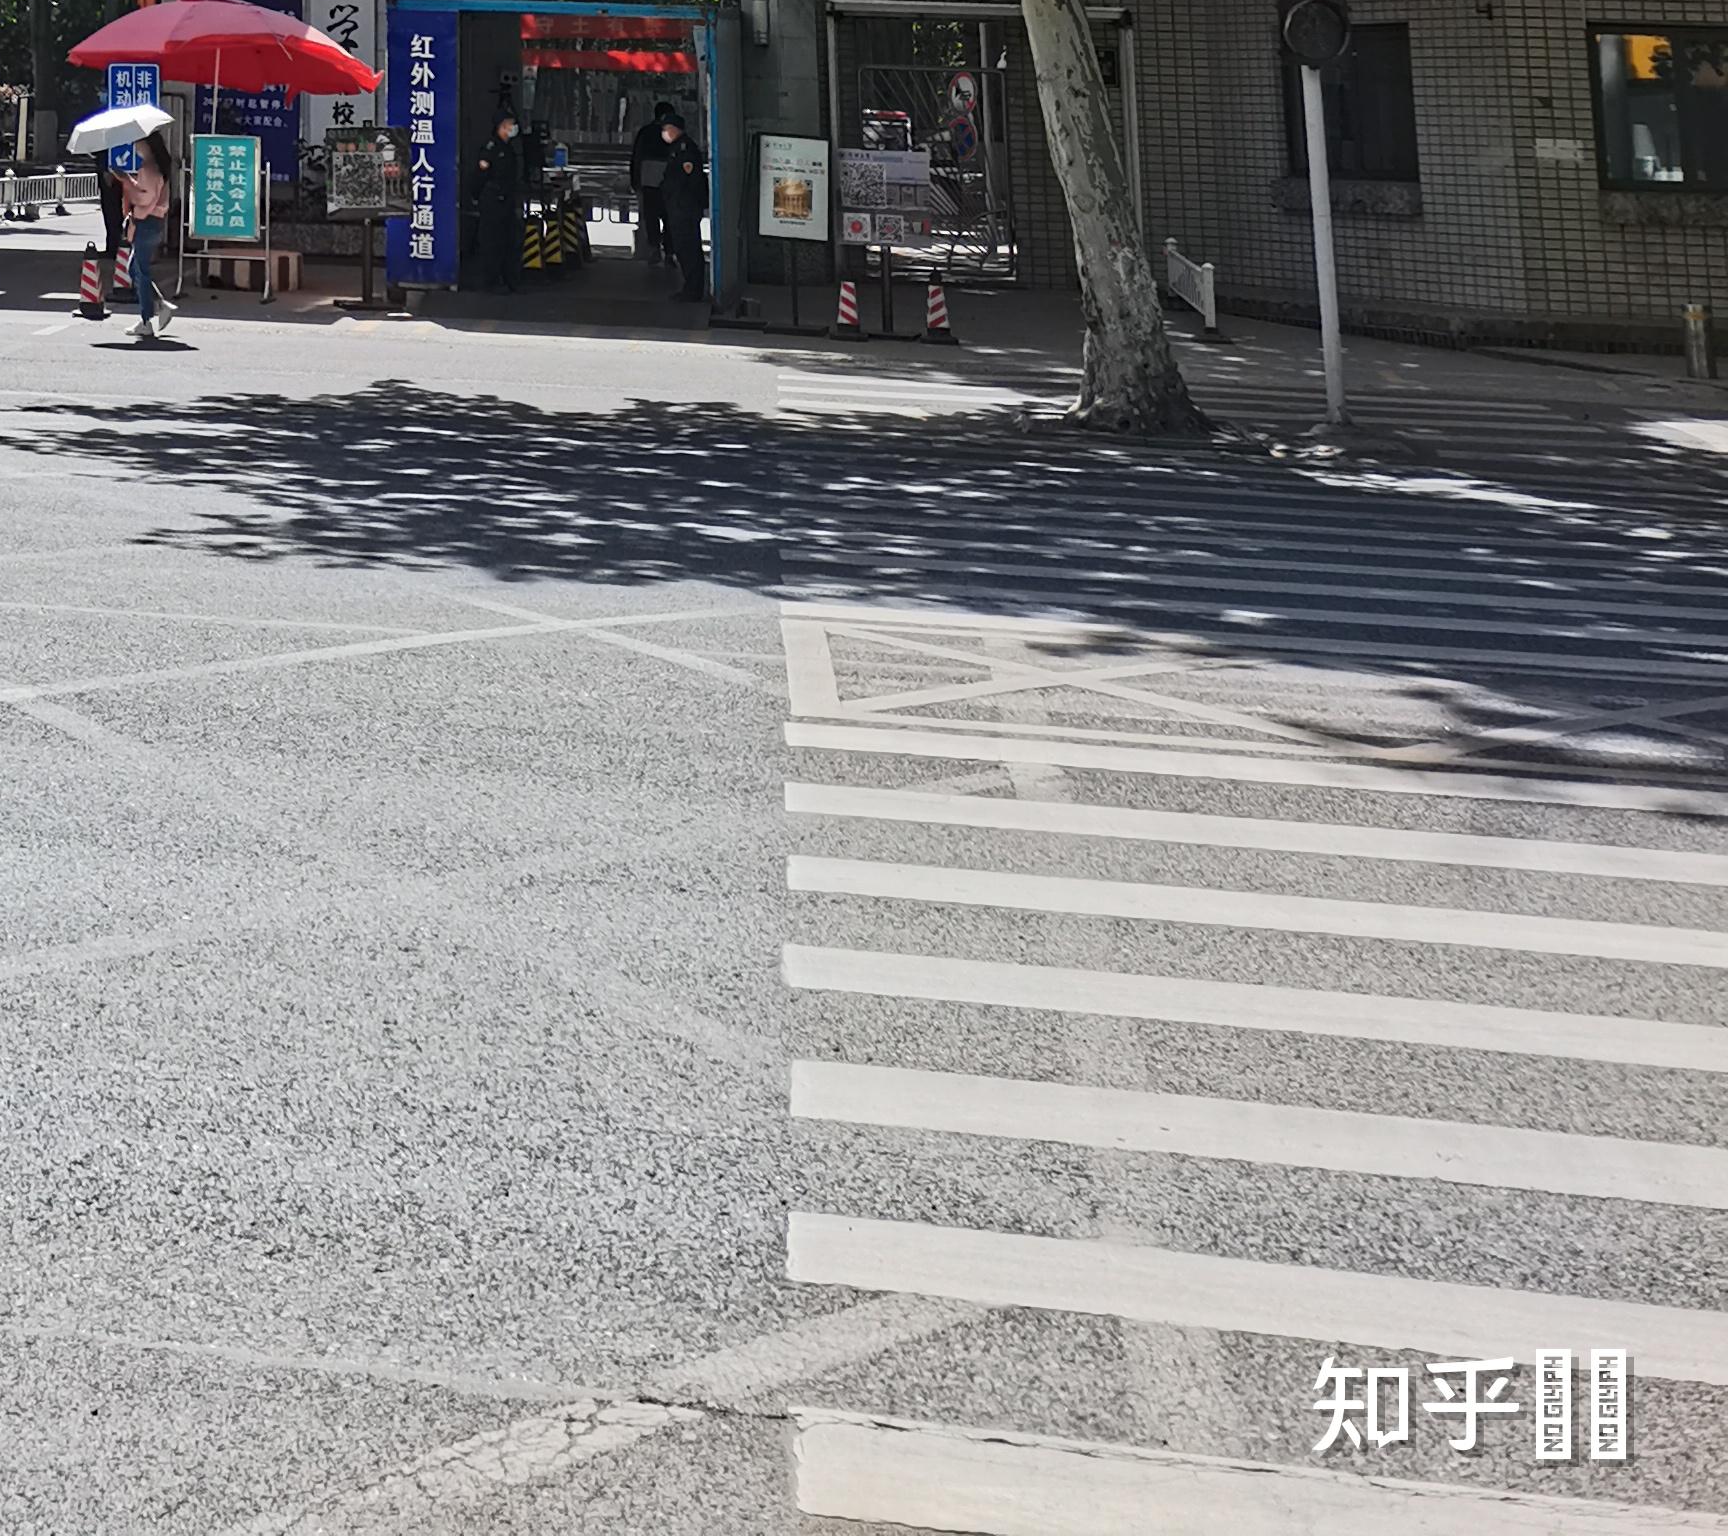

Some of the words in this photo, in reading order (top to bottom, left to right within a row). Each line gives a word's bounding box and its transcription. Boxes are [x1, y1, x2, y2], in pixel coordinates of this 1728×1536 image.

[206, 144, 224, 226] 及车辆进入校园
[227, 145, 247, 227] 禁止社会人员
[409, 33, 436, 261] 红外测温人行通道
